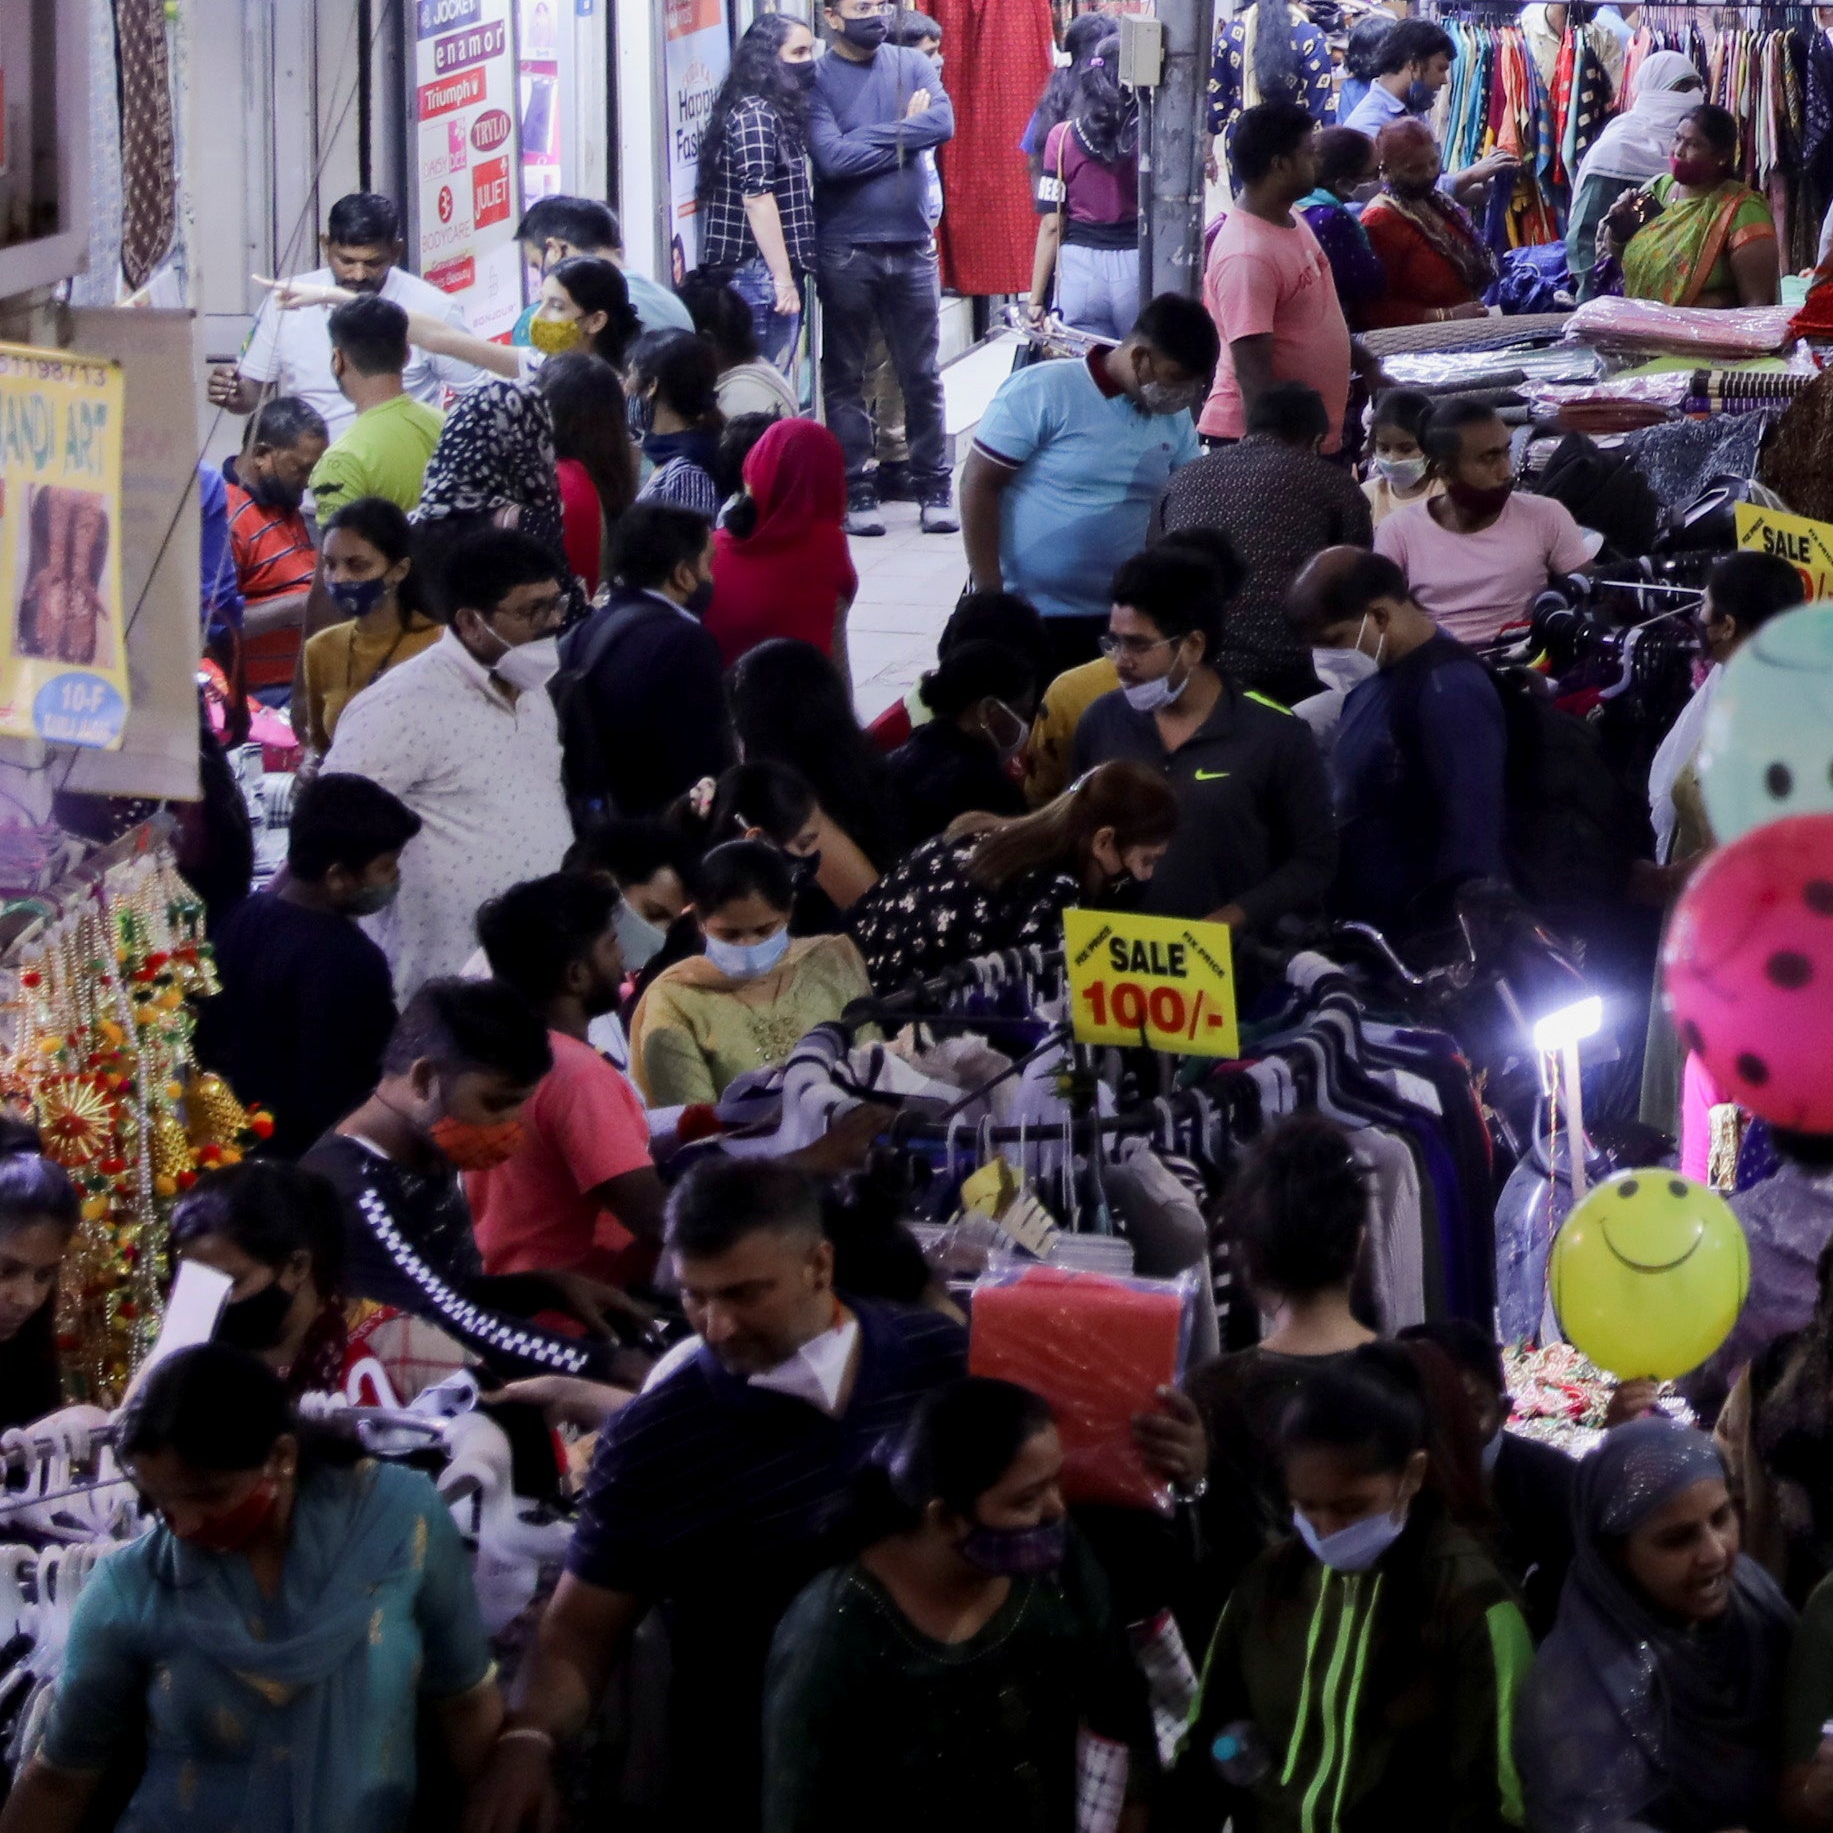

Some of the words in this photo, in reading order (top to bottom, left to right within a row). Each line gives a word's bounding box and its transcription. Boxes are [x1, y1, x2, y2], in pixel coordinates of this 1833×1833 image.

[435, 26, 504, 69] enamor
[425, 78, 472, 111] Triumph
[474, 115, 508, 148] TRYLO
[676, 128, 700, 165] Fash
[474, 177, 508, 221] JULIET
[421, 219, 472, 253] BODYCARE
[1763, 526, 1811, 564] SALE
[1109, 936, 1187, 979] SALE
[1183, 931, 1197, 949] FIX
[1198, 947, 1225, 979] PRICE
[1082, 980, 1223, 1041] 100/-
